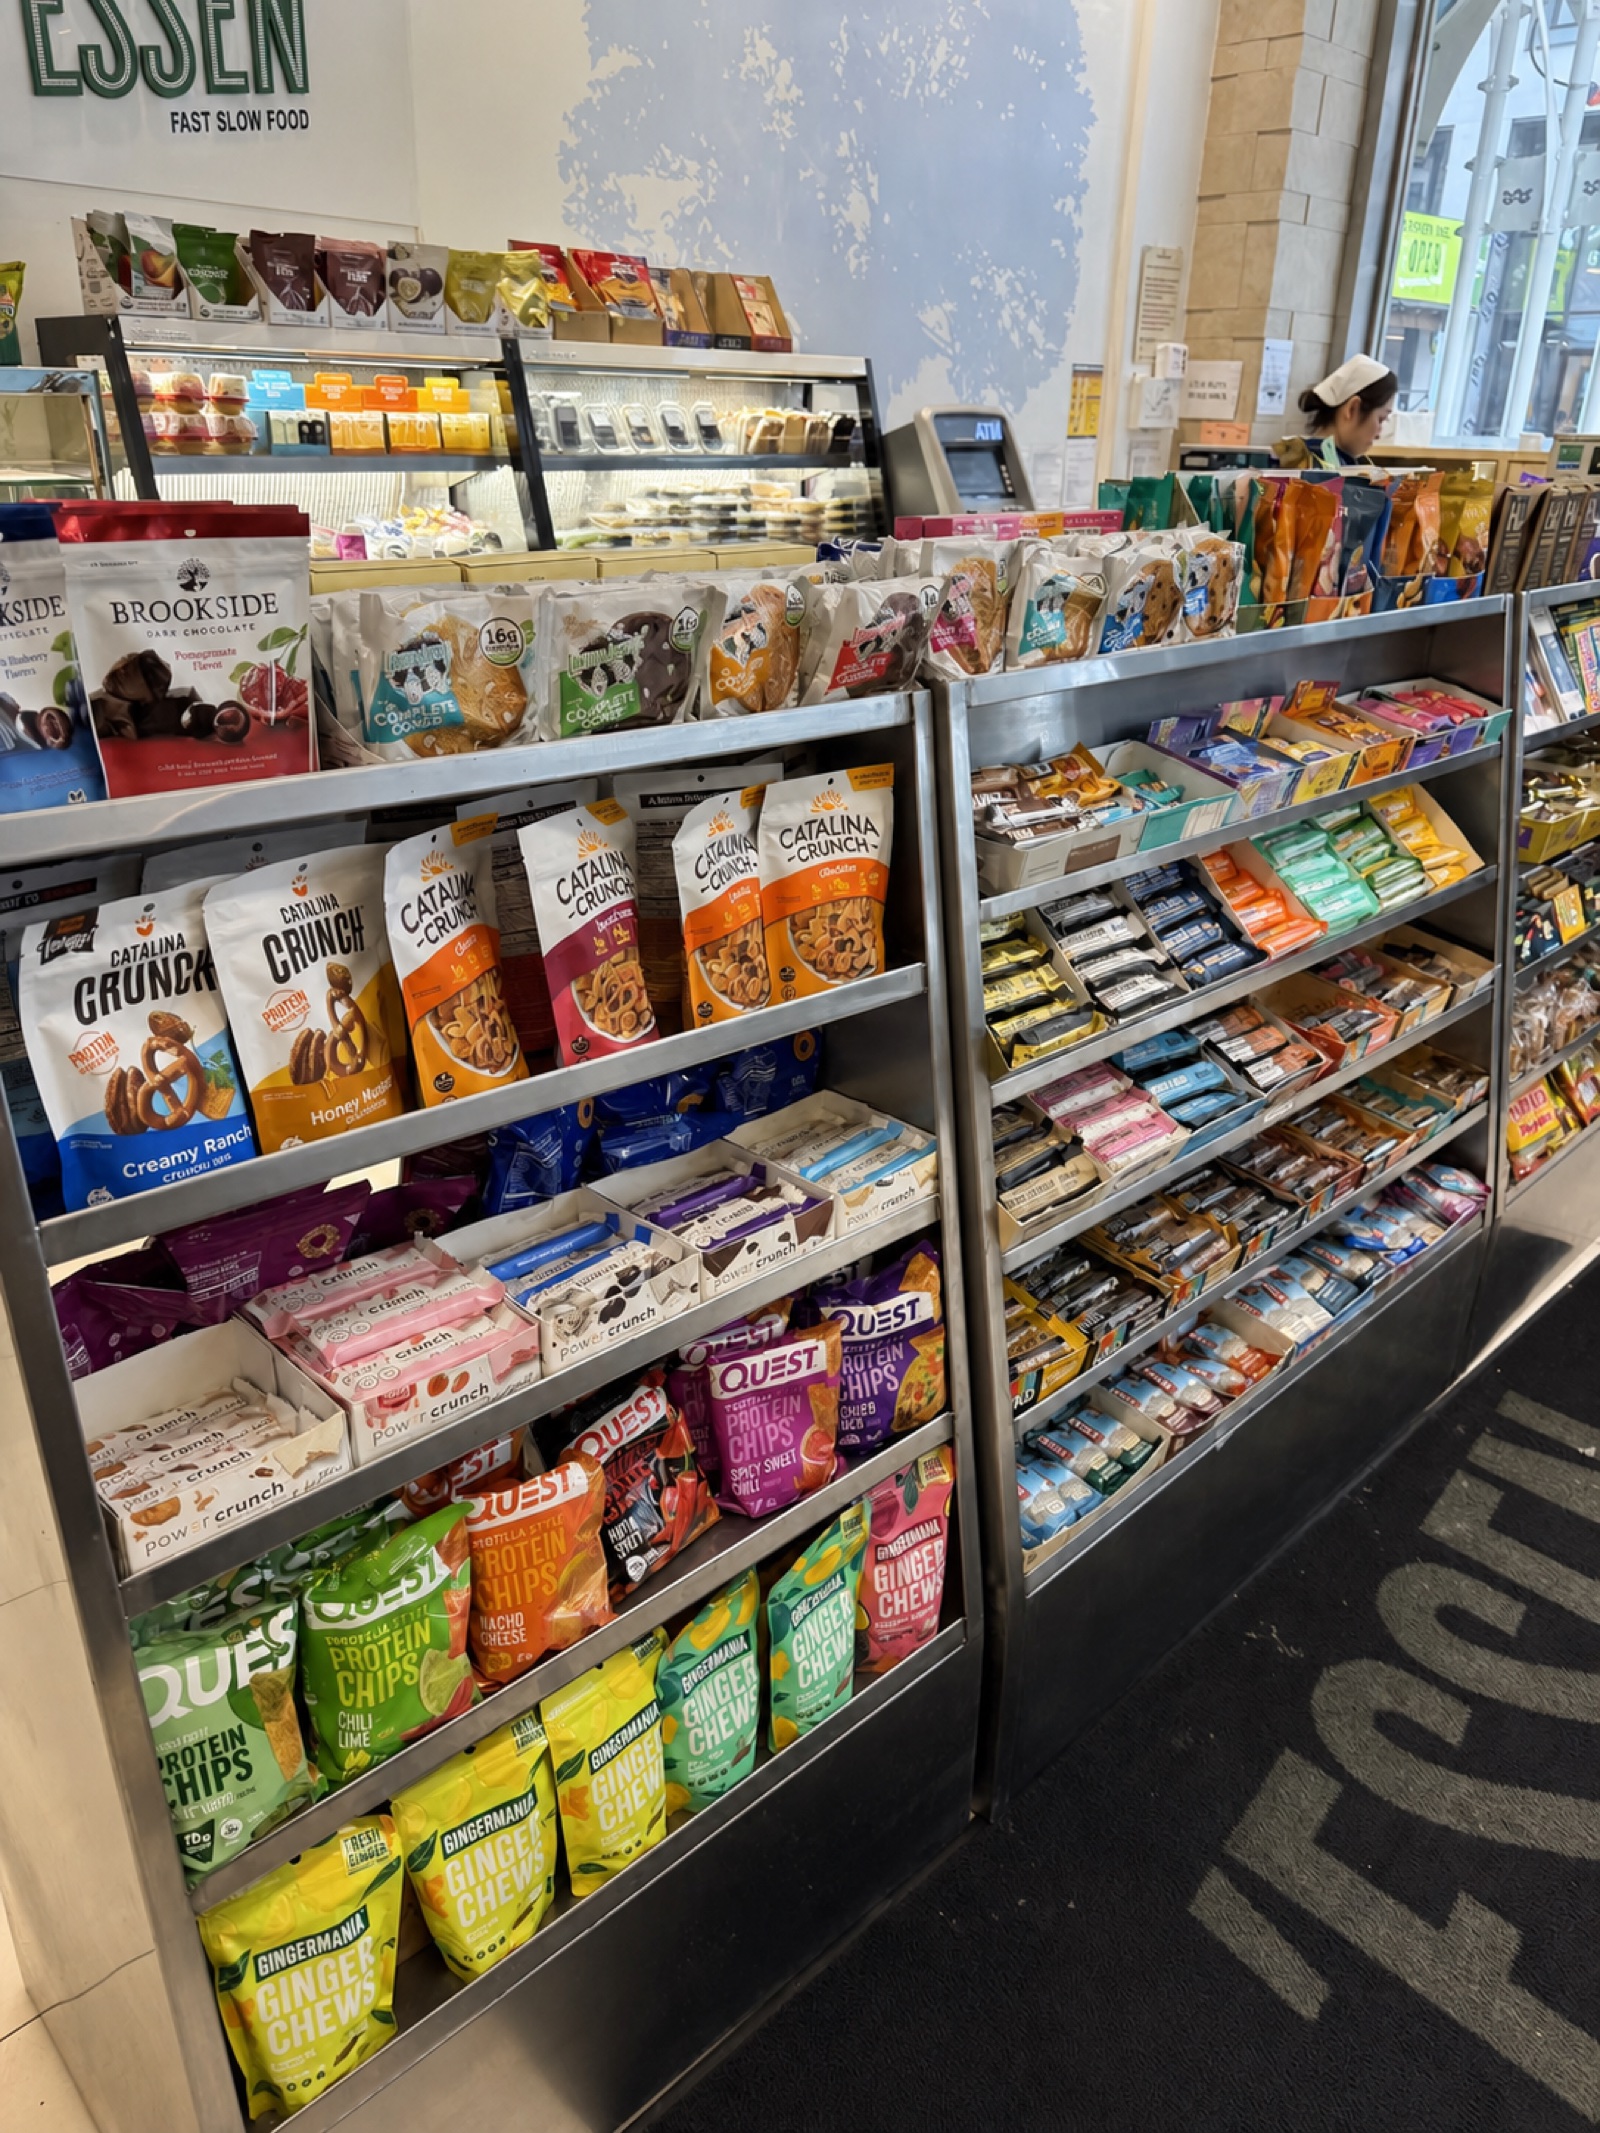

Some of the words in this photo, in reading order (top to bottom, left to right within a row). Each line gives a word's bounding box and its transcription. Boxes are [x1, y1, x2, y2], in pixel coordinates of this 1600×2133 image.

[171, 110, 210, 133] FAST
[217, 110, 261, 132] SLOW
[267, 109, 309, 131] FOOD
[109, 593, 279, 624] BROOKSIDE
[183, 623, 256, 637] CHOCOLATE
[779, 814, 879, 849] CATALINA
[796, 837, 869, 863] CRUNCH
[556, 851, 633, 904] CATALINA
[280, 893, 340, 925] CATALINA
[110, 932, 186, 967] CATALINA
[262, 906, 364, 985] CRUNCH
[74, 949, 217, 1025] CRUNCH
[311, 1098, 359, 1126] Honey
[122, 1145, 199, 1179] Creamy
[204, 1123, 251, 1152] Ranch
[756, 1242, 797, 1268] crunch
[607, 1306, 656, 1337] crunch
[827, 1297, 920, 1336] QUEST
[394, 1330, 453, 1359] crunch
[842, 1342, 904, 1374] ROTEIN
[720, 1345, 817, 1393] QUEST
[430, 1383, 489, 1417] crunch
[726, 1395, 801, 1436] PROTEIN
[574, 1390, 661, 1462] QUEST
[728, 1416, 794, 1464] CHIPS
[186, 1451, 252, 1483] crunch
[764, 1449, 798, 1473] SWEET
[214, 1482, 285, 1522] crunch
[464, 1465, 573, 1525] QUEST
[476, 1527, 566, 1578] PROTEIN
[874, 1537, 945, 1593] GINGER
[476, 1563, 558, 1611] CHIPS
[878, 1574, 944, 1619] CHEWS
[479, 1612, 524, 1630] NACHO
[480, 1628, 527, 1647] CHEESE
[792, 1590, 853, 1664] GINGER
[329, 1618, 431, 1671] PROTEIN
[336, 1652, 420, 1708] CHIPS
[682, 1653, 757, 1728] GINGER
[338, 1711, 373, 1731] CHILI
[338, 1729, 371, 1748] LIME
[444, 1793, 534, 1854] GINGERMANIA
[457, 1840, 544, 1928] CHEWS
[257, 1915, 365, 1977] GINGERMANIA
[255, 1936, 375, 2024] GINGER
[266, 1970, 376, 2057] CHEWS
